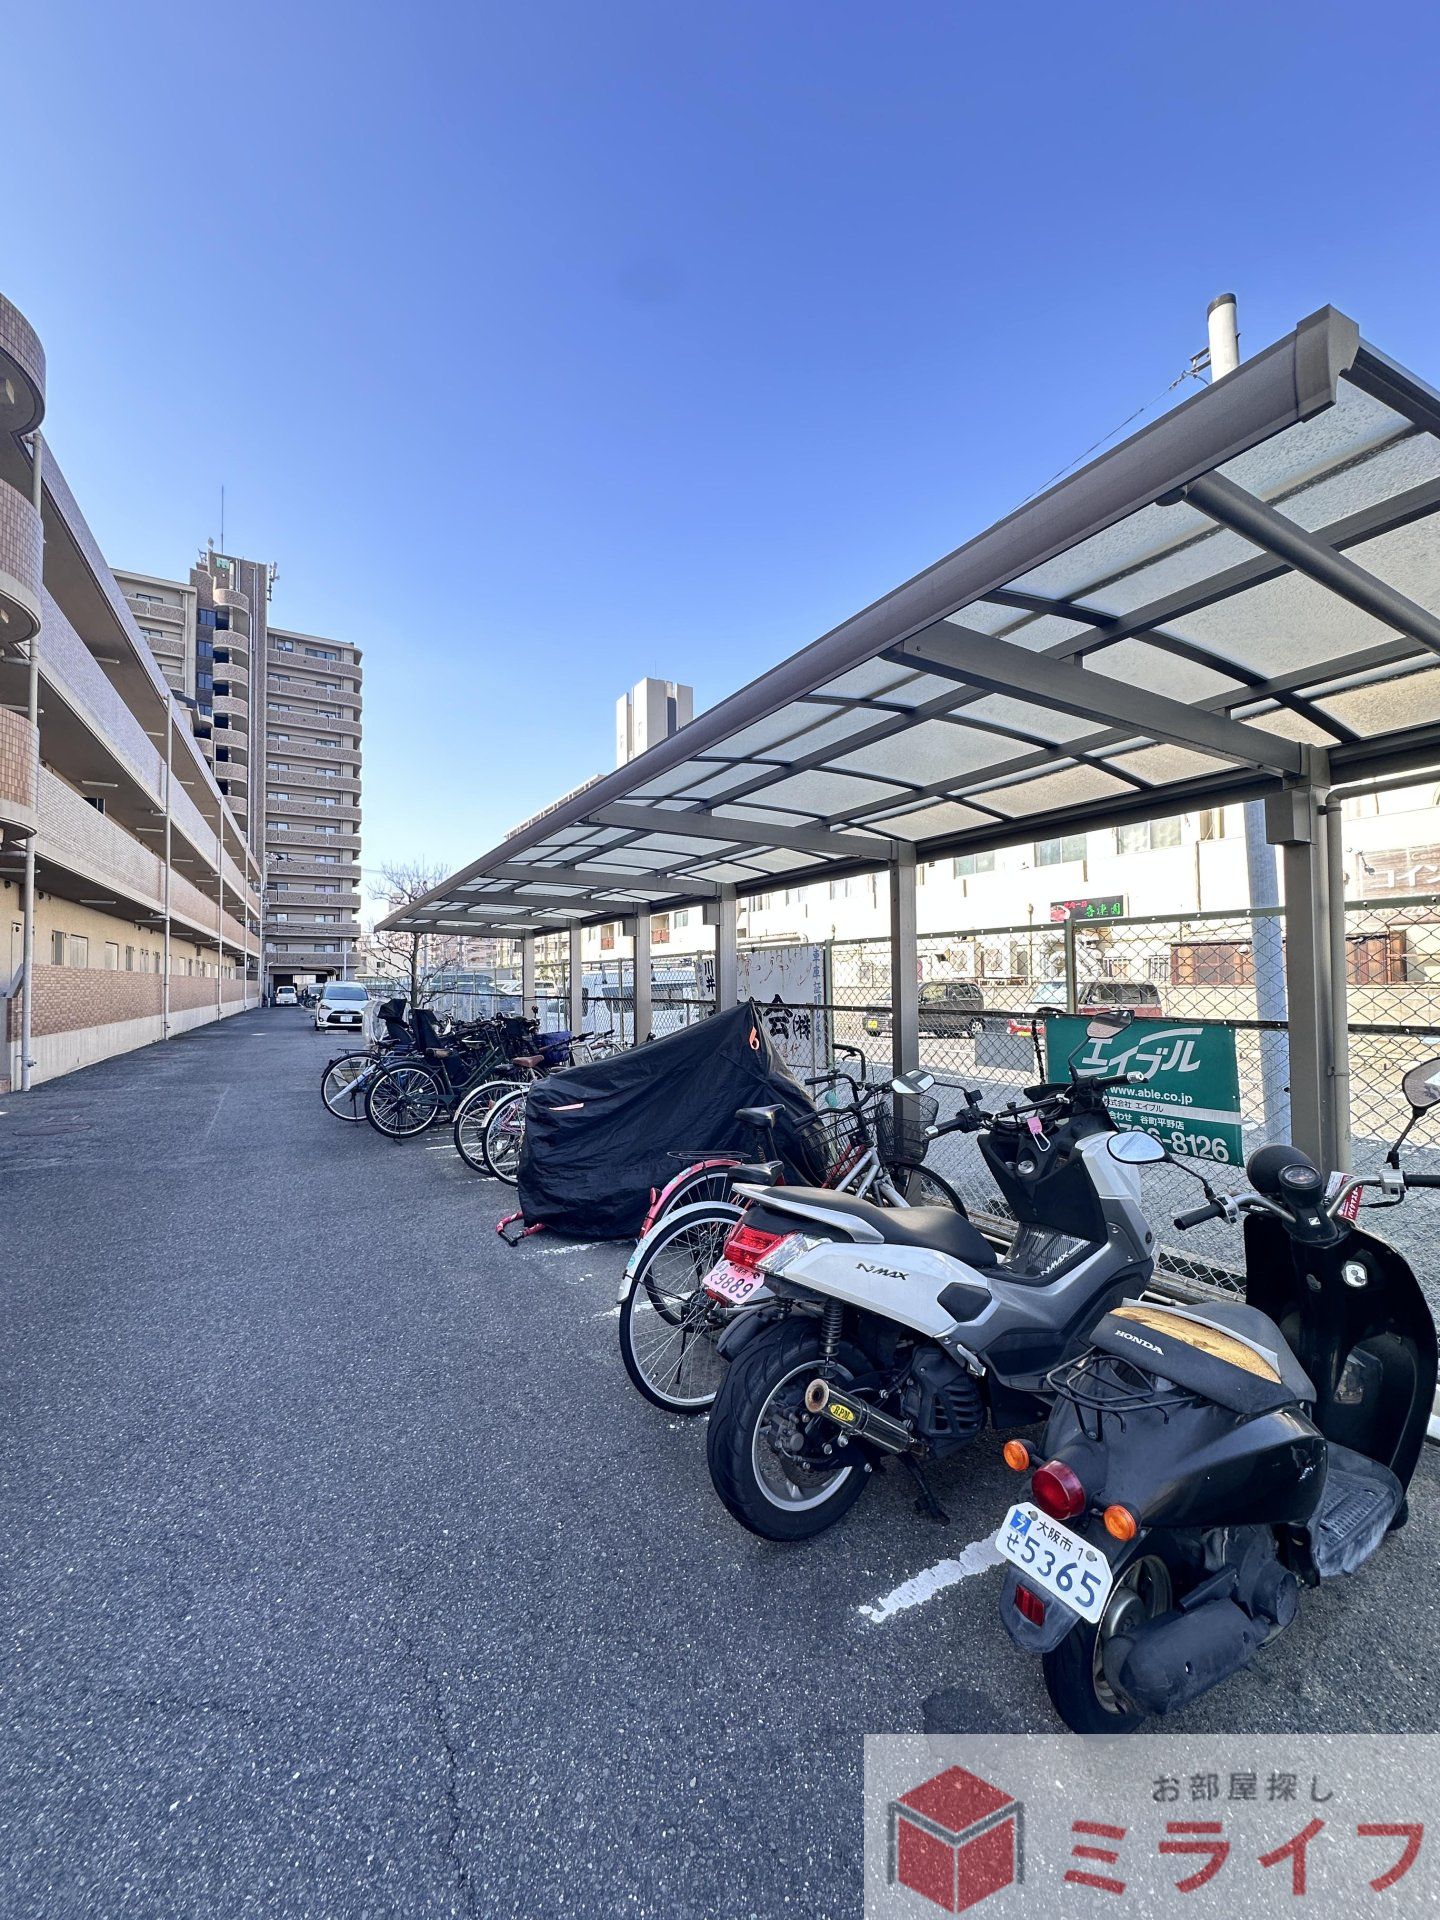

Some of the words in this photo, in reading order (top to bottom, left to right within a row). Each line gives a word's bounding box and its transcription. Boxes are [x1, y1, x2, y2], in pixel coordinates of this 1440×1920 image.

[1080, 1036, 1201, 1080] エイブル
[1109, 1086, 1193, 1105] www.able.co.jp
[1140, 1115, 1185, 1131] 谷町平野店
[1114, 1329, 1165, 1356] HONDA
[833, 1405, 851, 1420] RPM
[1036, 1521, 1073, 1552] 大阪市
[1020, 1536, 1102, 1608] 5365
